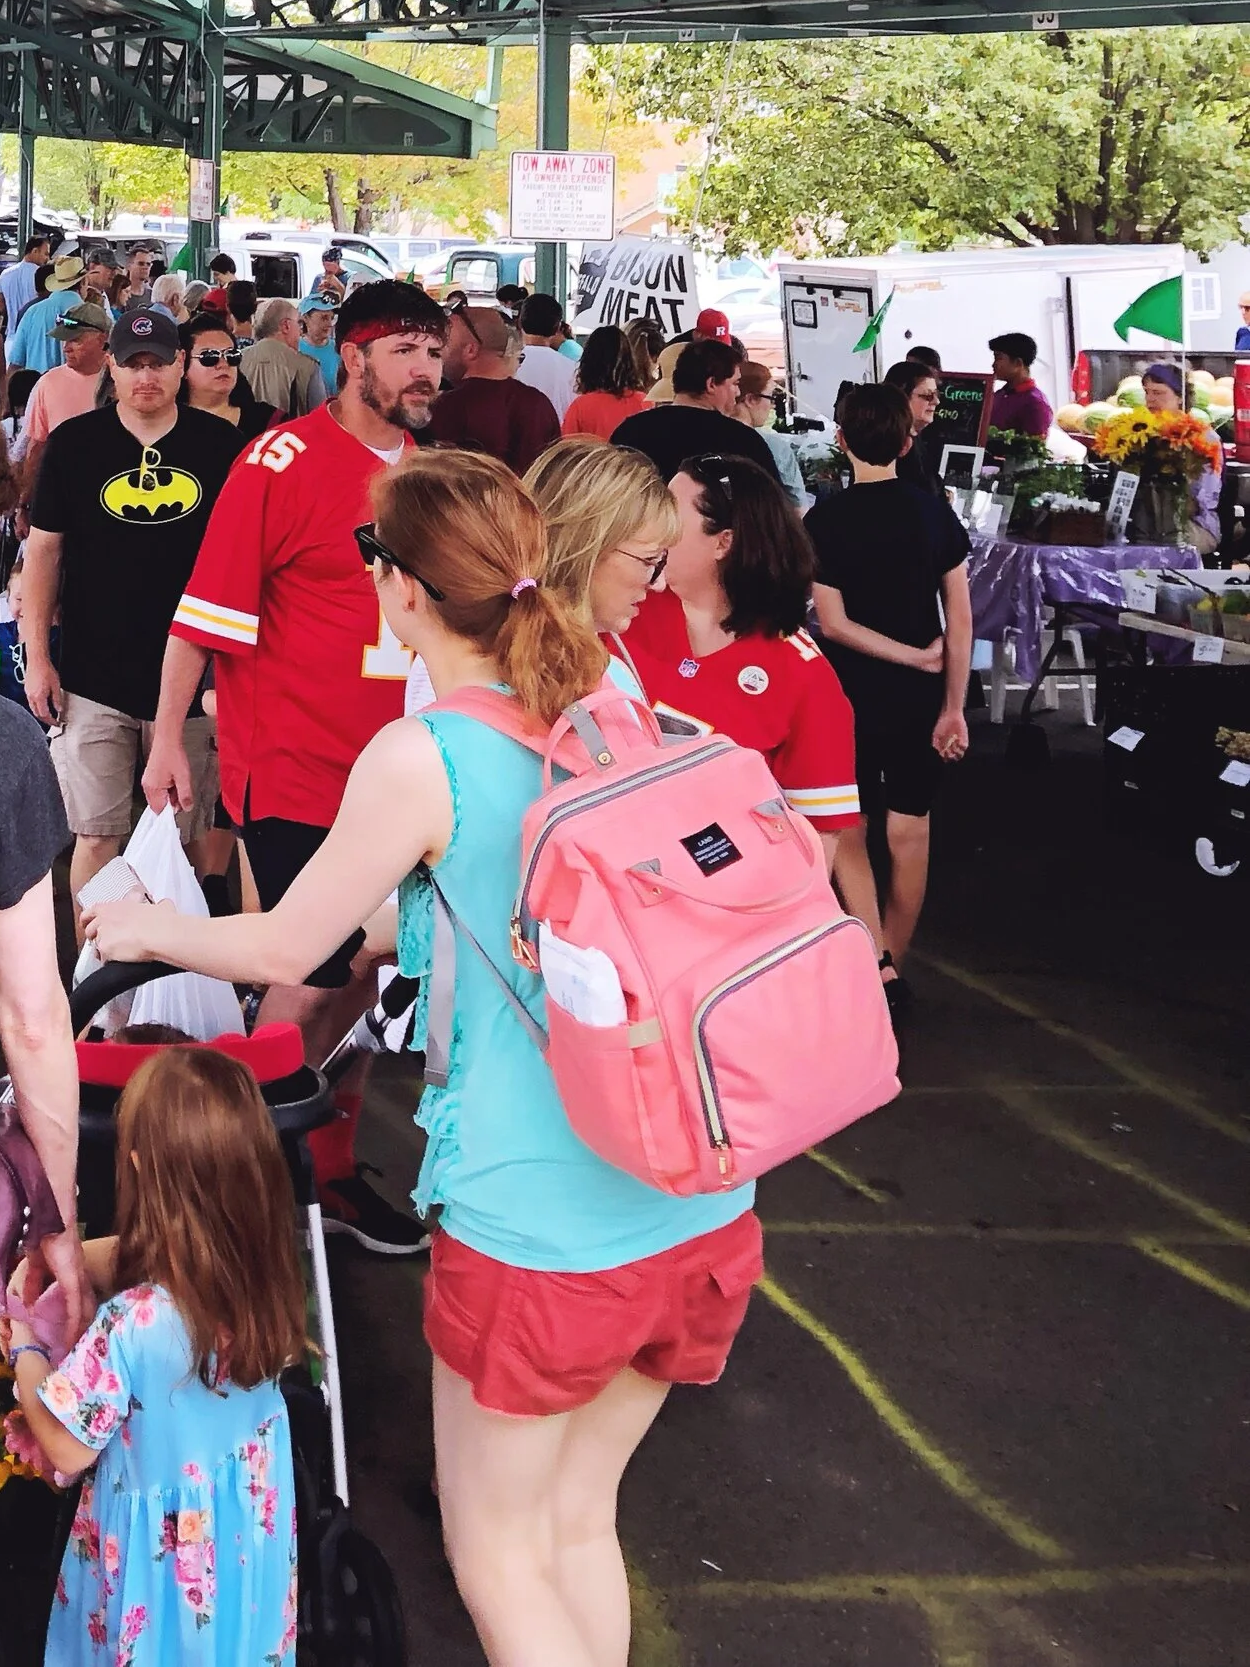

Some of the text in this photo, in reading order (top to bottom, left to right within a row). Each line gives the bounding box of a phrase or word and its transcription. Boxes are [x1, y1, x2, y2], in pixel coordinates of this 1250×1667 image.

[516, 155, 611, 174] TOW AWAY ZONE
[571, 175, 607, 184] EXPENSE
[610, 247, 688, 293] BISON
[599, 287, 685, 334] MEAT
[716, 326, 726, 336] R
[245, 429, 308, 474] 15
